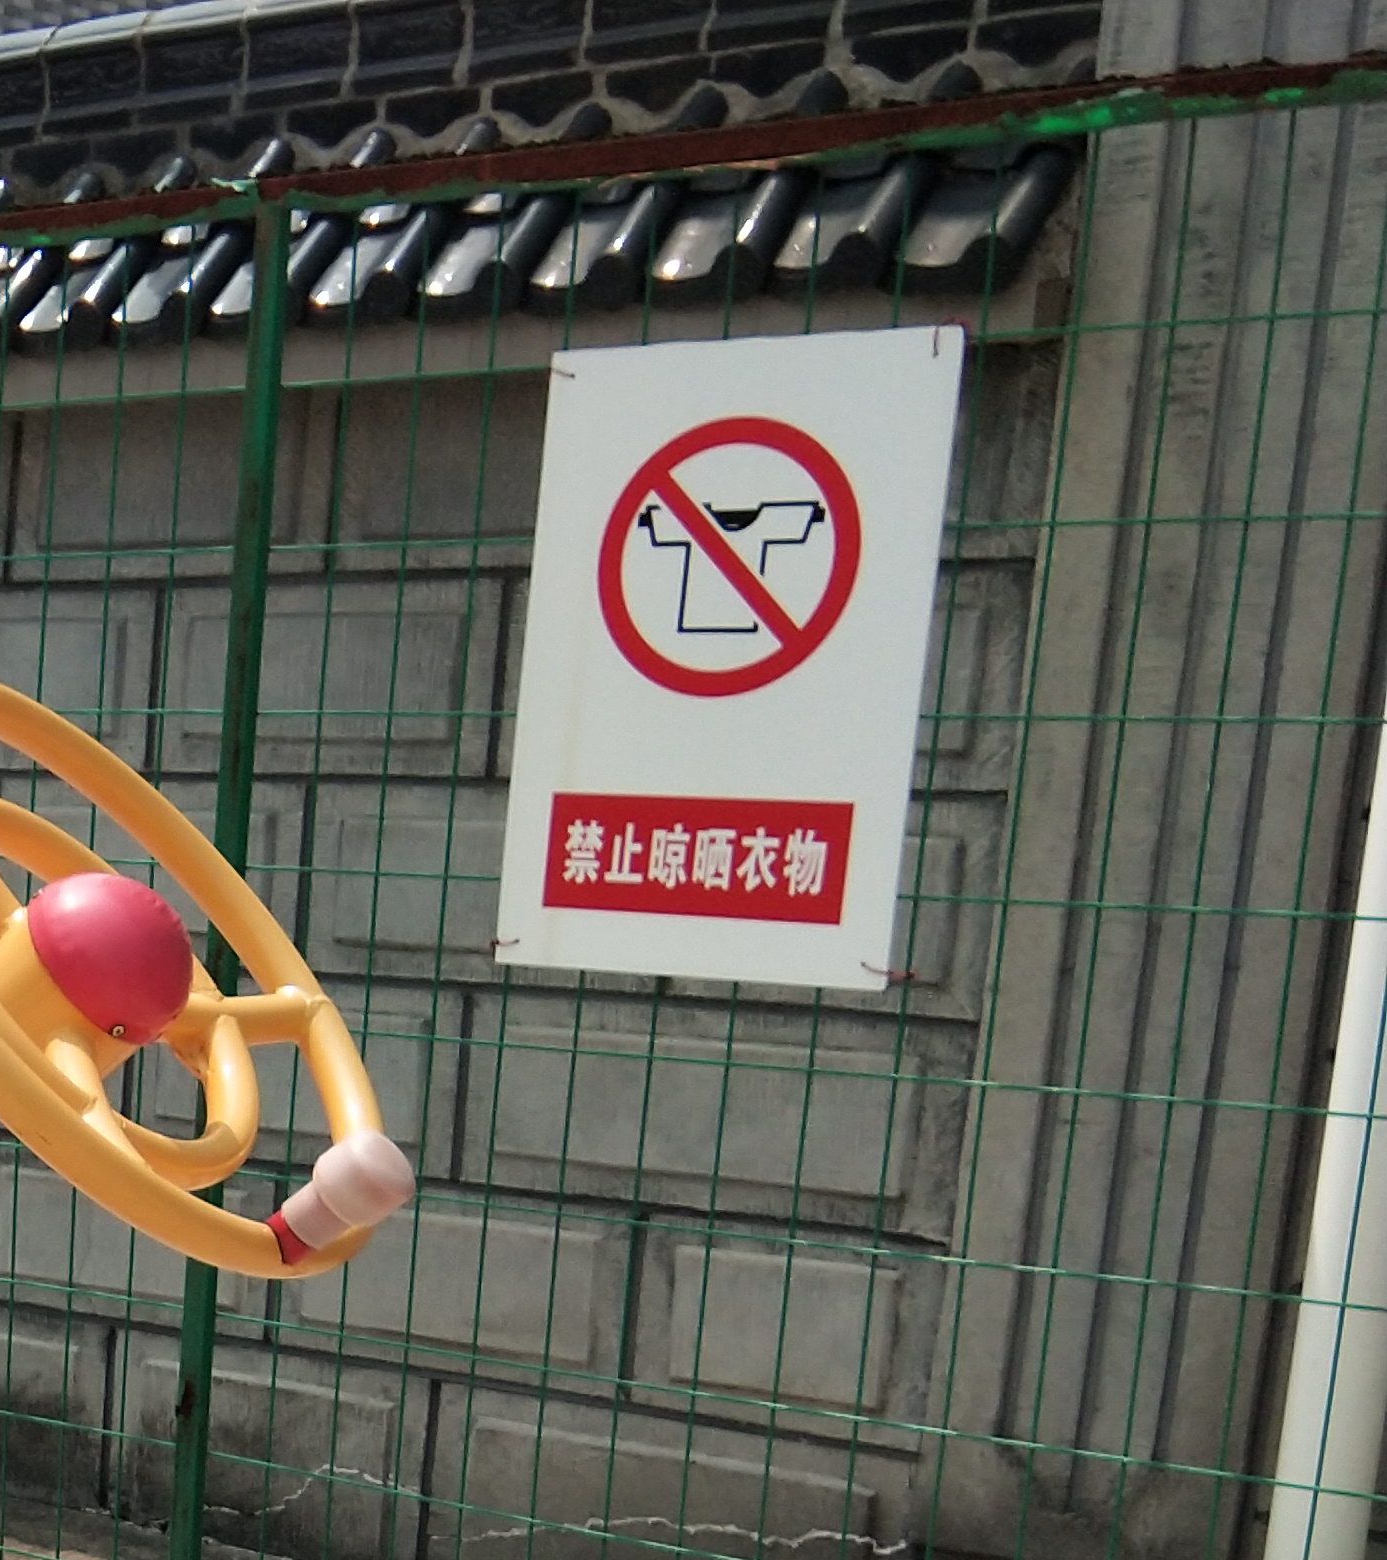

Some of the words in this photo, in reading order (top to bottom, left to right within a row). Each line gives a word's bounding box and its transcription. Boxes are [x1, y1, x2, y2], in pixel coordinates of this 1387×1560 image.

[561, 818, 828, 898] 禁止晾晒衣物
